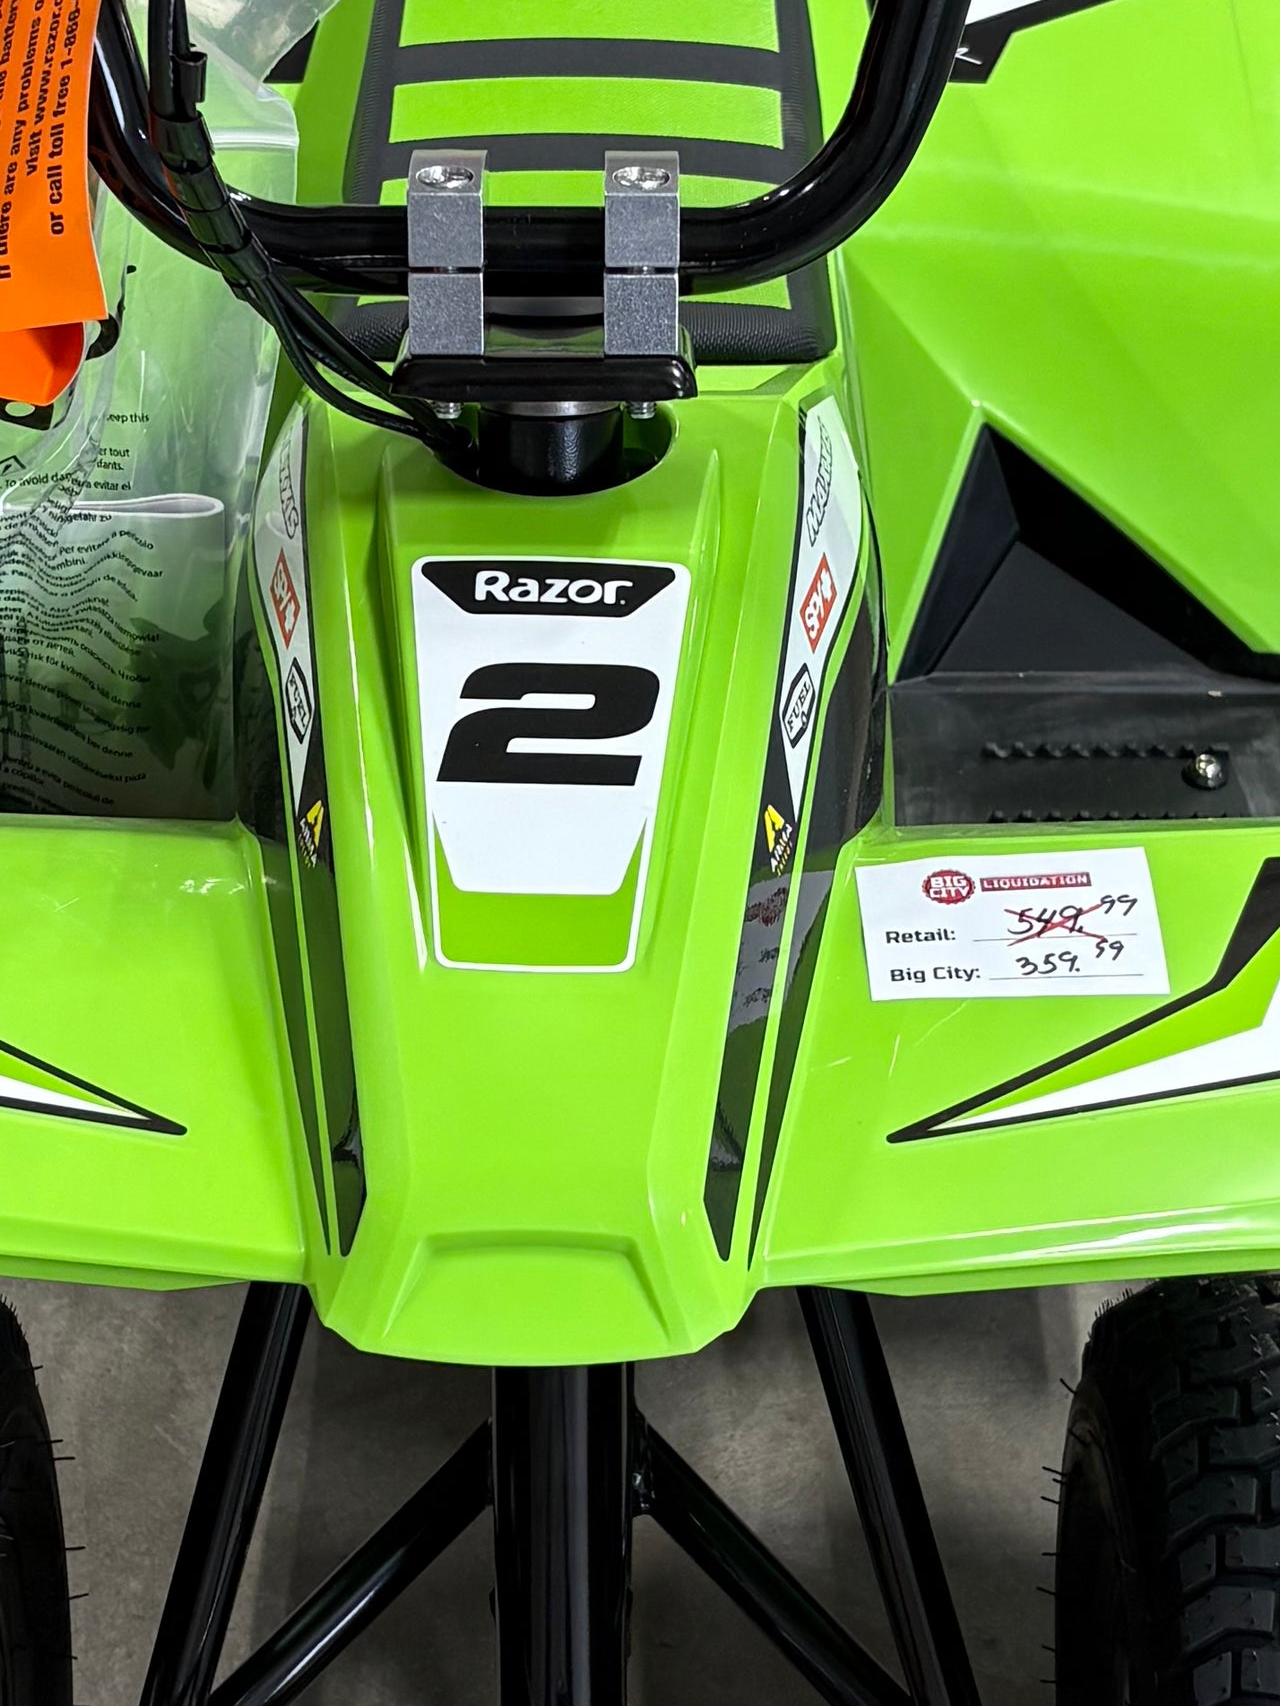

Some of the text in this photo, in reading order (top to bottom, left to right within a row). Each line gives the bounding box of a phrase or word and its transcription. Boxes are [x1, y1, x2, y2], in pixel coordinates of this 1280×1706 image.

[18, 16, 42, 114] problems
[52, 74, 71, 119] free
[10, 119, 27, 156] any
[26, 129, 43, 177] visit
[48, 122, 65, 159] toll
[4, 161, 19, 196] are
[47, 164, 63, 205] call
[50, 211, 65, 235] or
[130, 413, 150, 424] this
[93, 481, 119, 492] evitar
[475, 570, 634, 605] Razor
[436, 662, 661, 786] 2
[785, 679, 813, 741] FUEL
[929, 875, 968, 890] BIG
[929, 886, 970, 900] CITY
[982, 874, 1089, 890] LIQUIDATION
[885, 927, 956, 945] Retail:
[890, 967, 926, 983] Big
[933, 965, 982, 982] City:
